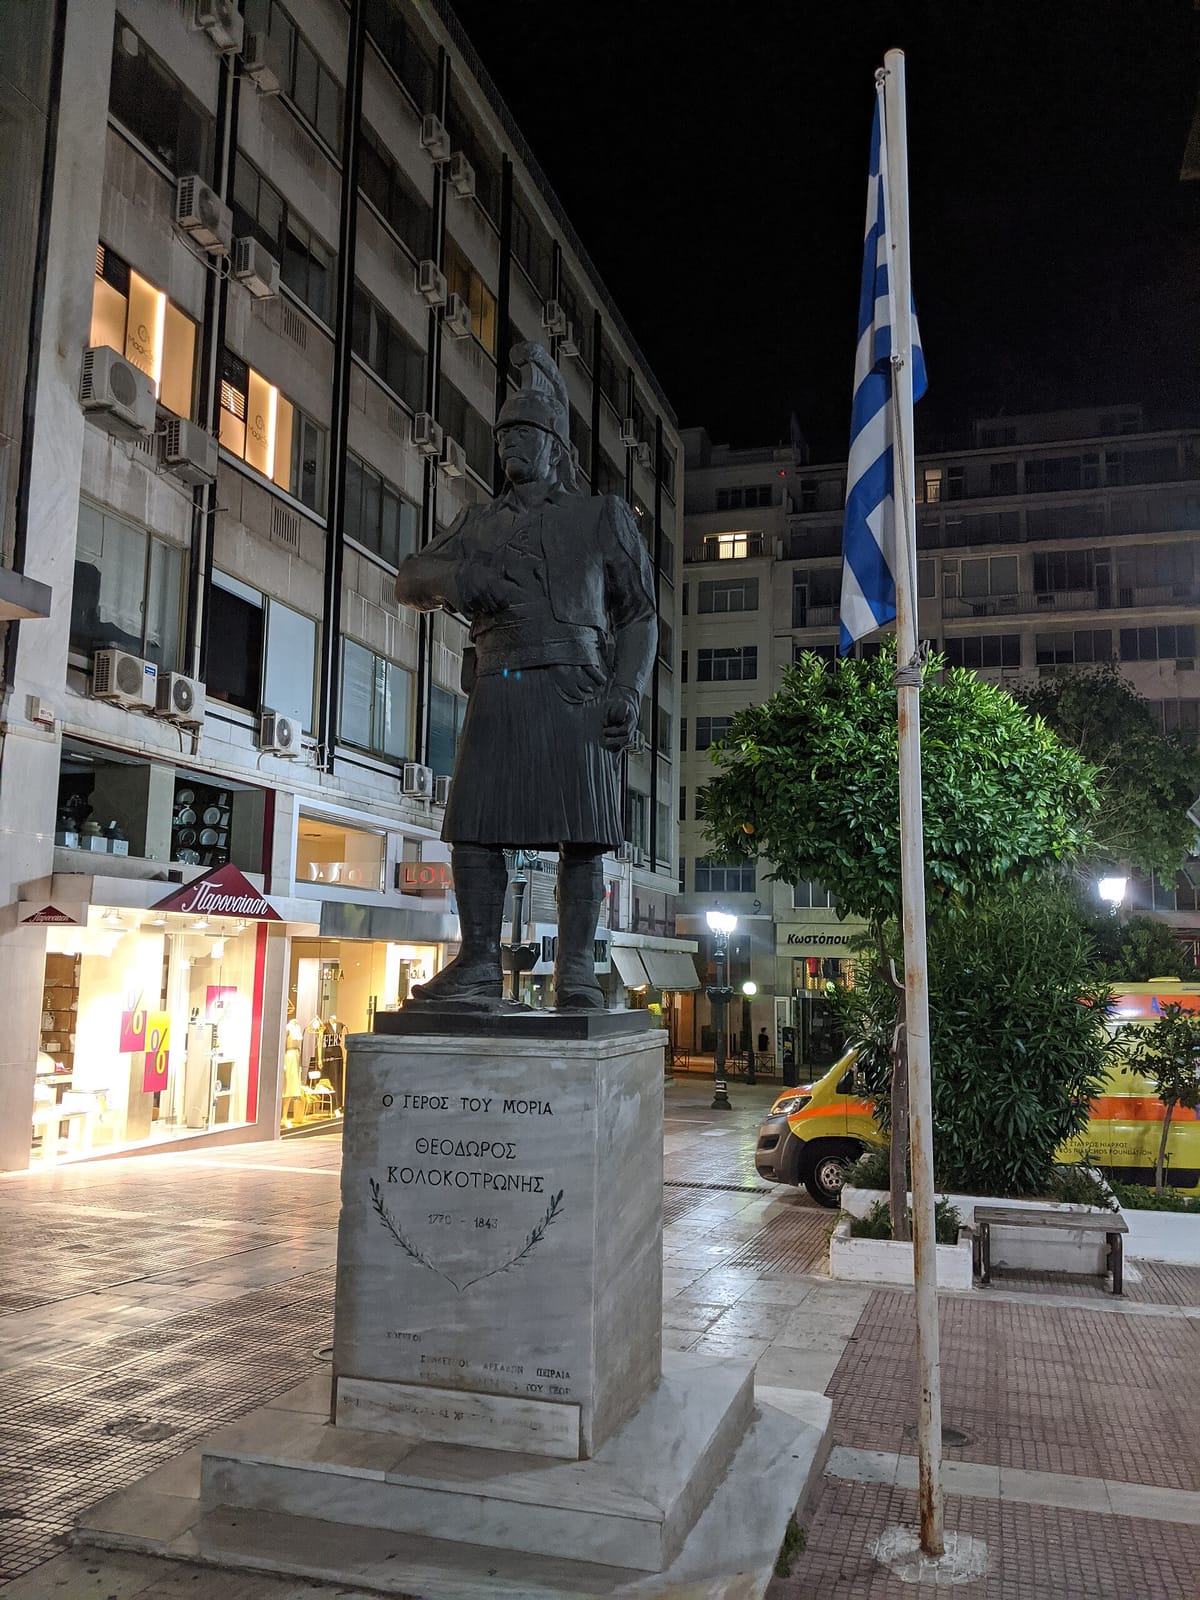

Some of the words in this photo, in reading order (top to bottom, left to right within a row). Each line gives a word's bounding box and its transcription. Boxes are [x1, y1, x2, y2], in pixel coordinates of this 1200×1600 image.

[404, 866, 452, 885] LOL
[787, 932, 850, 945] Κωστόπου
[382, 1094, 394, 1107] Ο
[403, 1095, 449, 1110] ΓΕΡΟΣ
[460, 1097, 492, 1113] ΤΟΥ
[502, 1099, 554, 1116] ΜΟΡΙΑ
[415, 1137, 517, 1160] ΘΕΟΔΩΡΟΣ
[387, 1165, 545, 1194] ΚΟΛΟΚΟΤΡΩΝΗΣ
[473, 1217, 499, 1230] 1843
